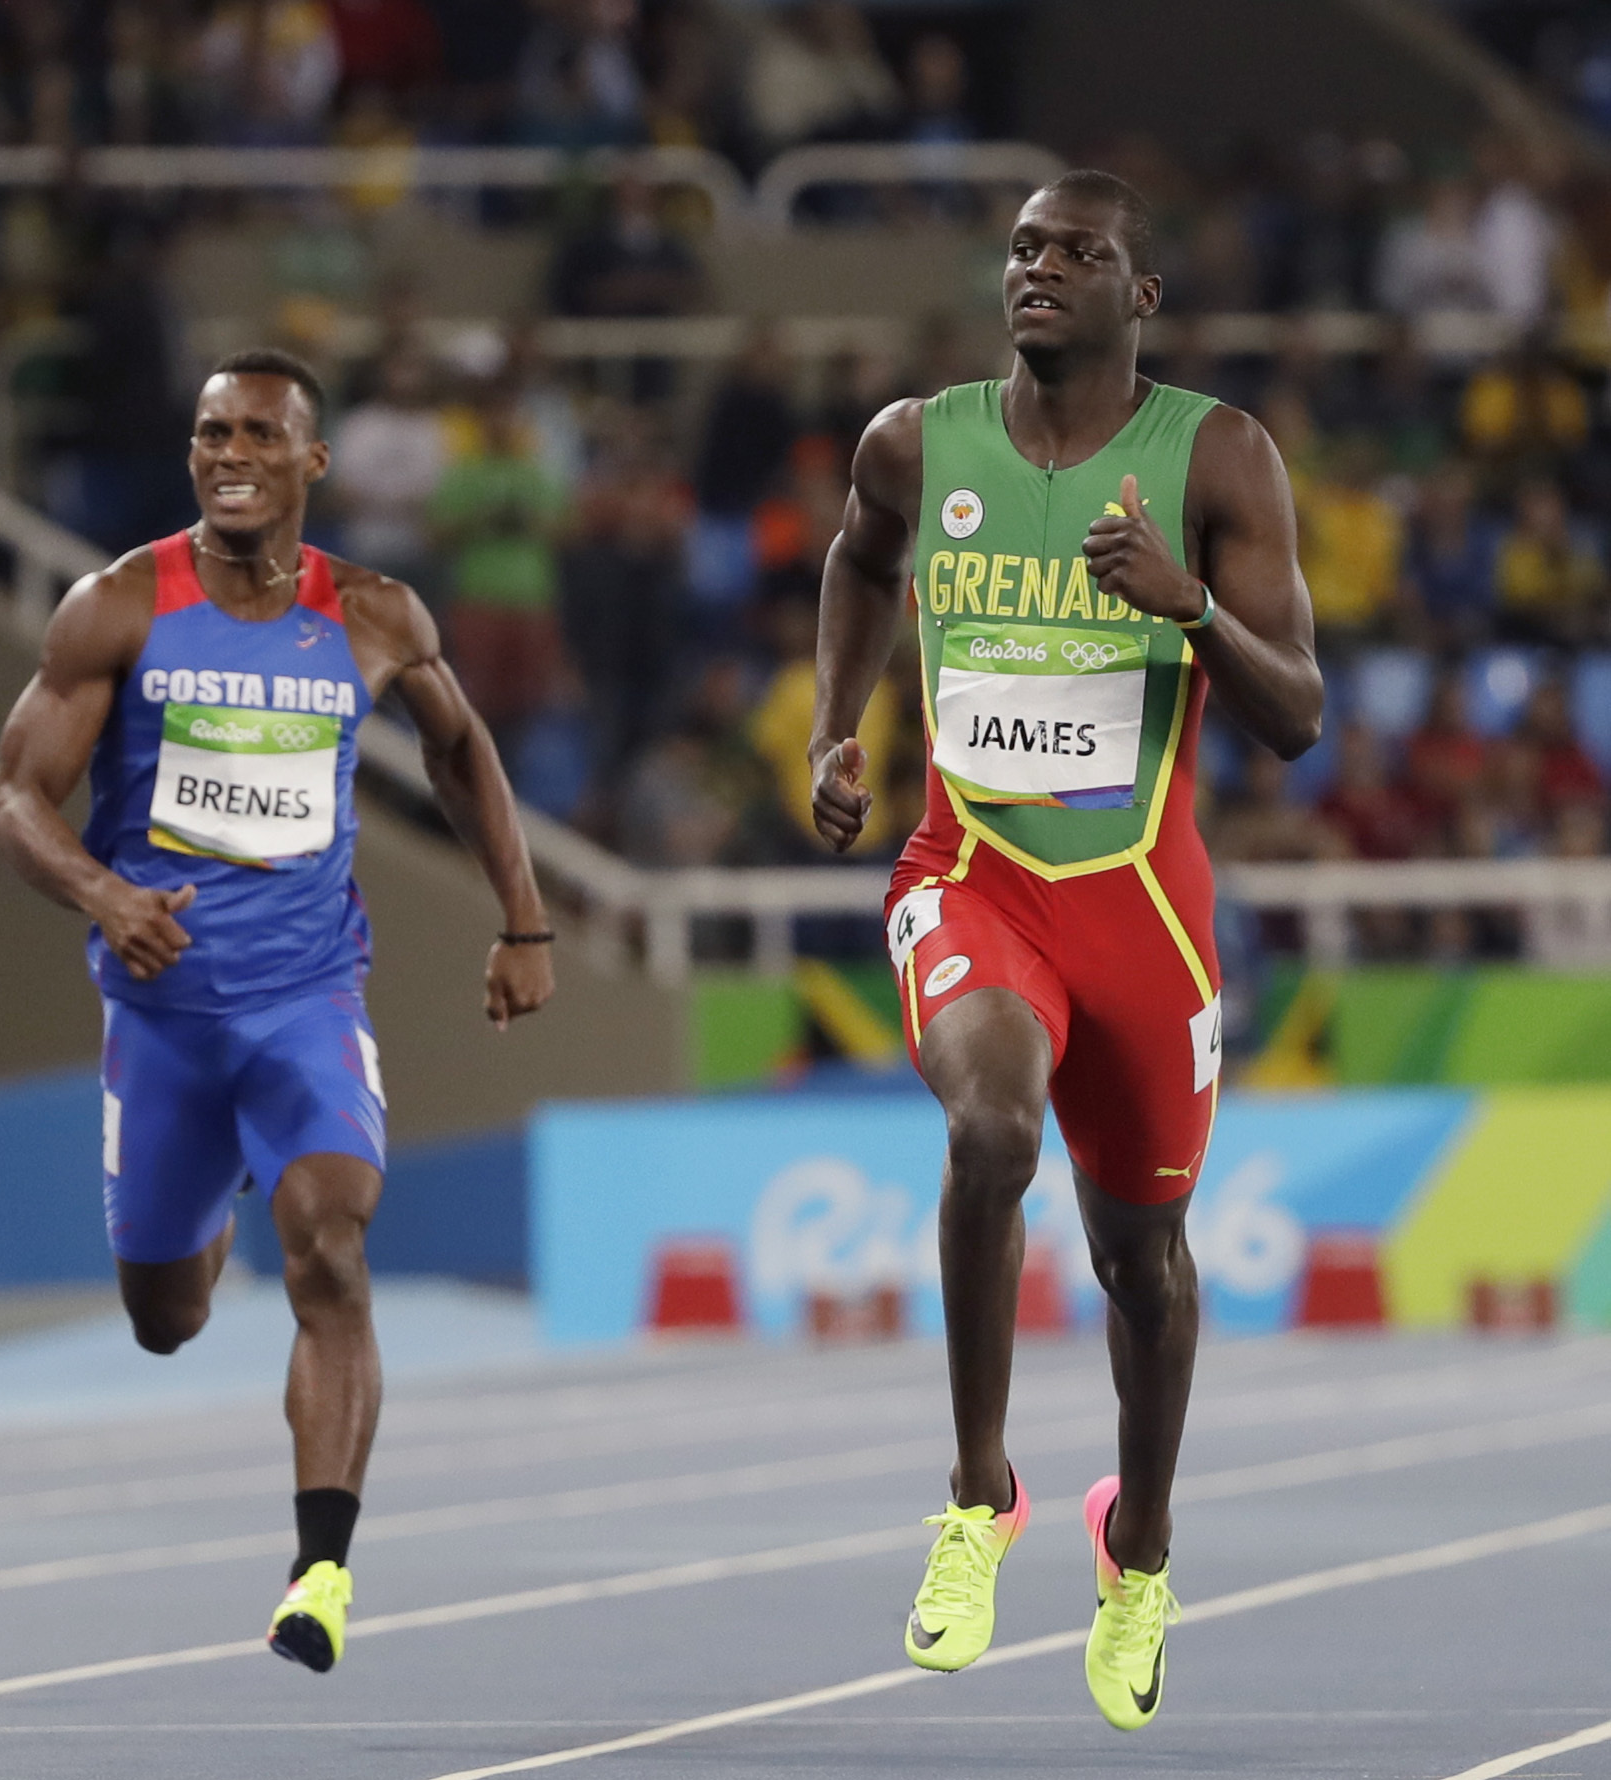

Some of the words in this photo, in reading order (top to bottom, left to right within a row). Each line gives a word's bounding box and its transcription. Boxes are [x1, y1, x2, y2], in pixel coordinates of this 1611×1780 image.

[930, 551, 1164, 623] GRENA
[970, 637, 1047, 662] Rio2016
[142, 669, 266, 707] COSTA
[273, 676, 356, 716] RICA
[190, 718, 263, 743] Rio2016
[968, 714, 1097, 757] JAMES
[177, 775, 310, 819] BRENES
[897, 905, 916, 947] 4
